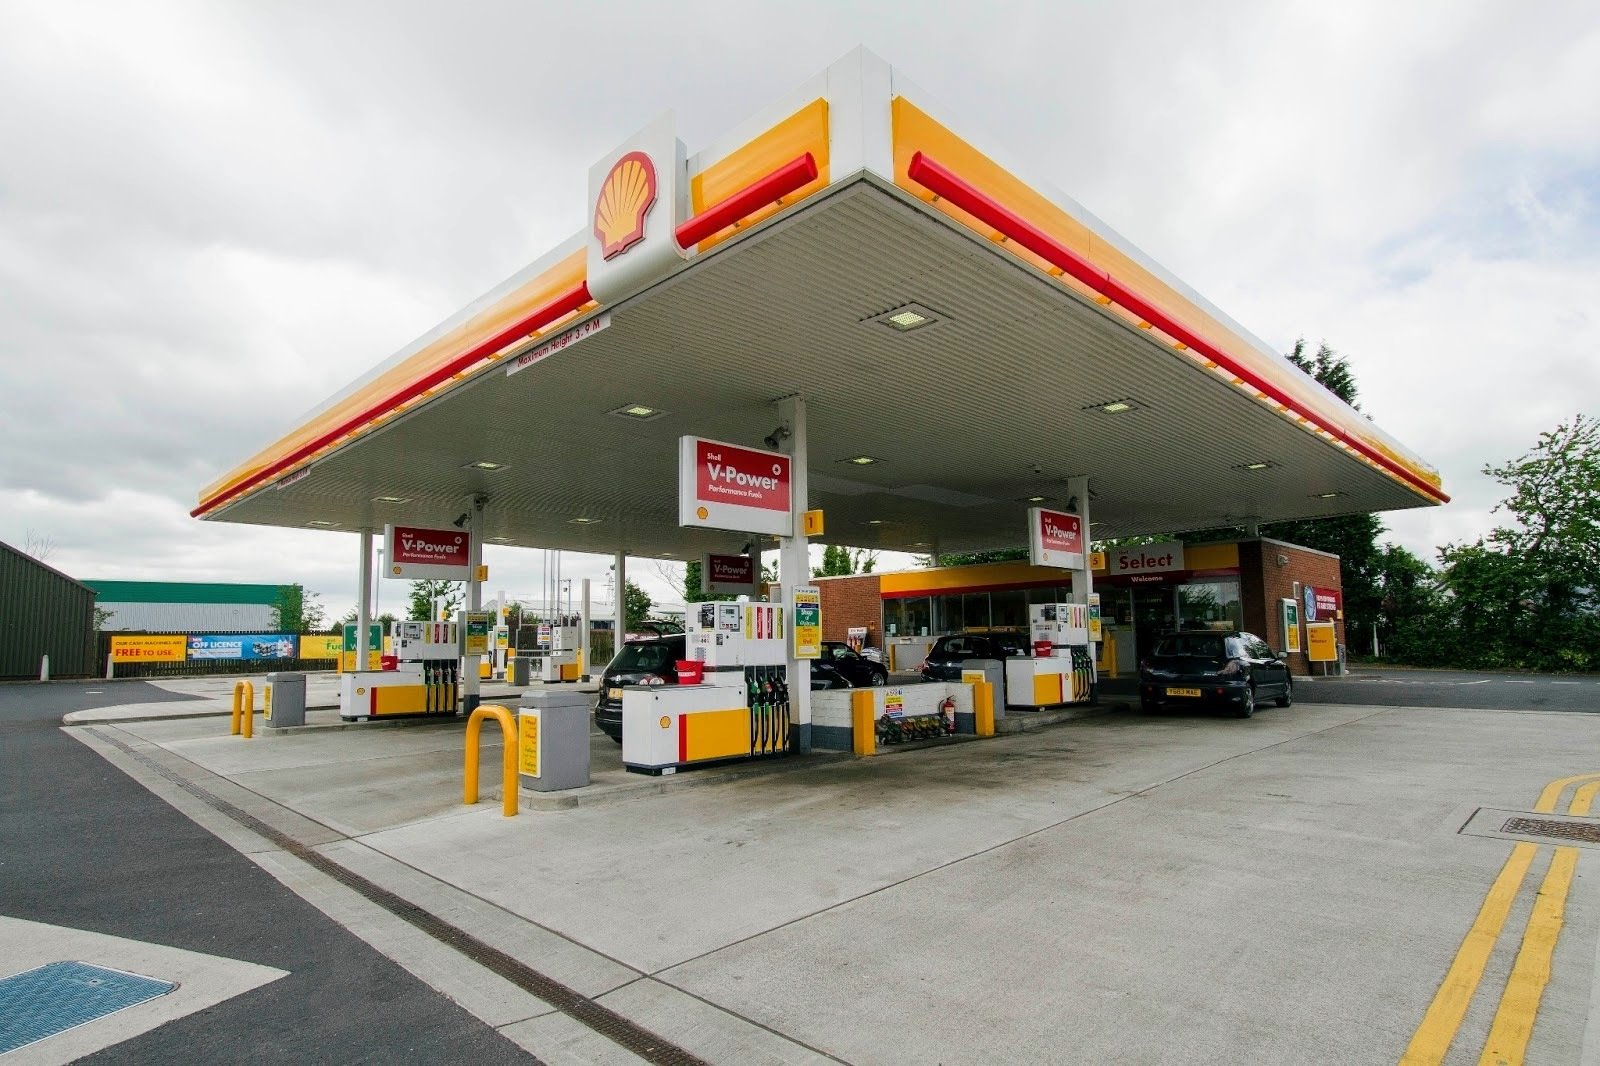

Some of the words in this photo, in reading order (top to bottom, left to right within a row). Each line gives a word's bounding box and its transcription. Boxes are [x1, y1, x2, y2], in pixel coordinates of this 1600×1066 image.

[517, 347, 549, 367] Maximum
[551, 333, 573, 351] Height
[707, 452, 721, 461] Shell
[707, 462, 778, 491] V-Power
[708, 484, 748, 497] Performance
[748, 490, 763, 499] Fuels
[809, 517, 813, 528] 1
[1045, 524, 1076, 540] V-Power
[401, 539, 460, 554] V-Power
[1119, 553, 1174, 570] Select
[714, 564, 748, 575] V-Power
[116, 648, 141, 657] FREE
